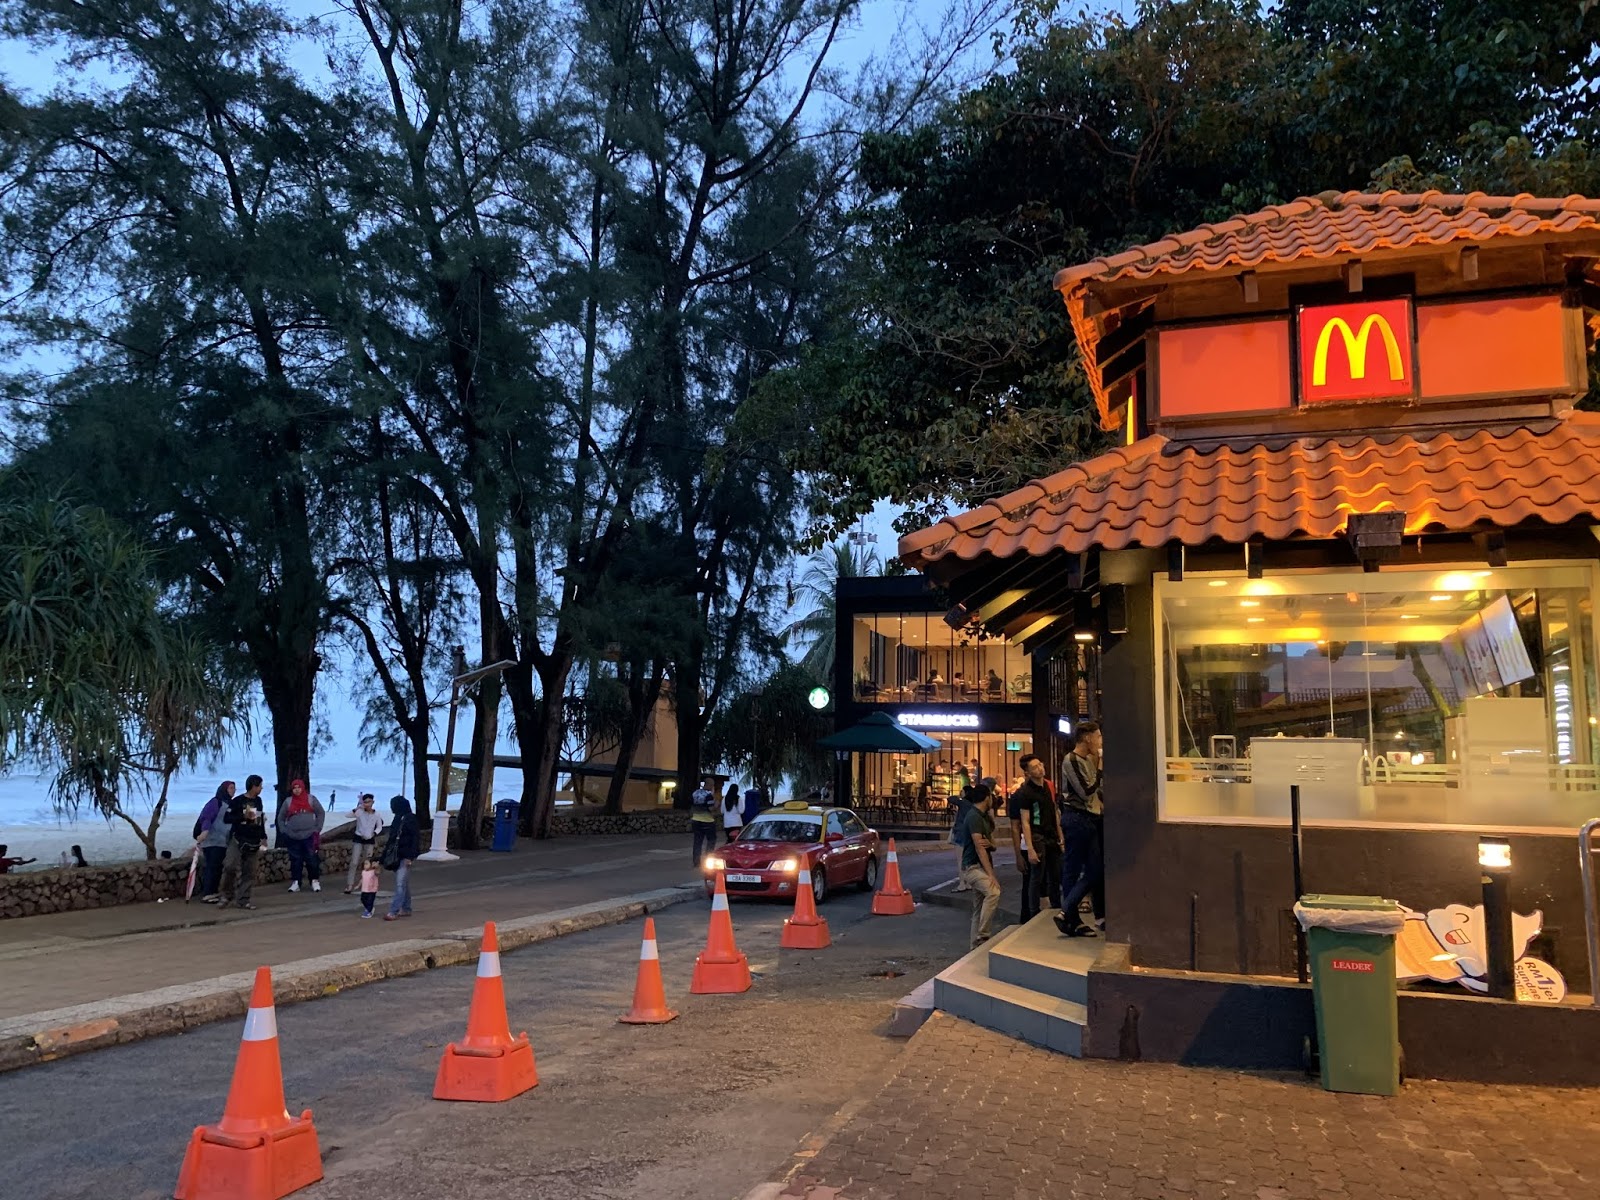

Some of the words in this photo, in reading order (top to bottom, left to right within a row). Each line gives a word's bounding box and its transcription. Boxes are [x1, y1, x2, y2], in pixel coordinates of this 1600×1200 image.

[898, 713, 979, 726] STARBUCKS
[1333, 961, 1372, 971] LEADER
[1515, 964, 1541, 1000] Sundae
